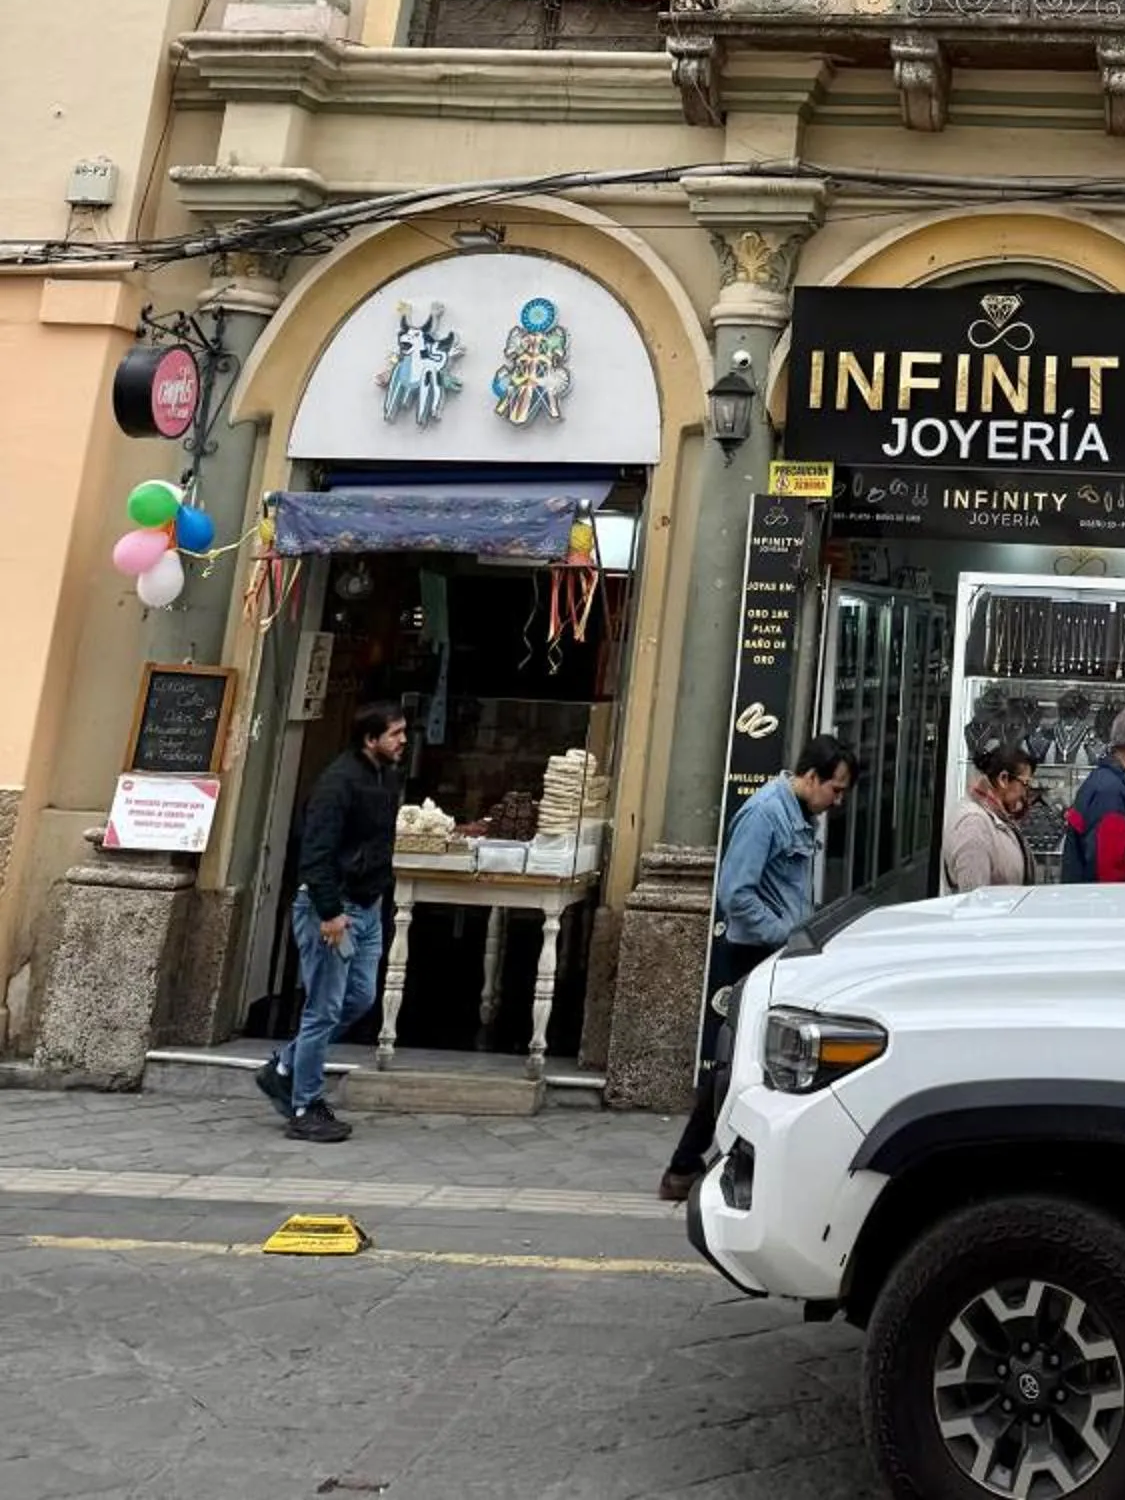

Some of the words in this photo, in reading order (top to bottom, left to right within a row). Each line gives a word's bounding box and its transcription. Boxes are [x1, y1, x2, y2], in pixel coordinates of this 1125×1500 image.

[881, 408, 1110, 462] JOYERÍA
[942, 488, 1068, 512] INFINITY
[752, 624, 782, 634] PLATA
[753, 655, 775, 665] ORO
